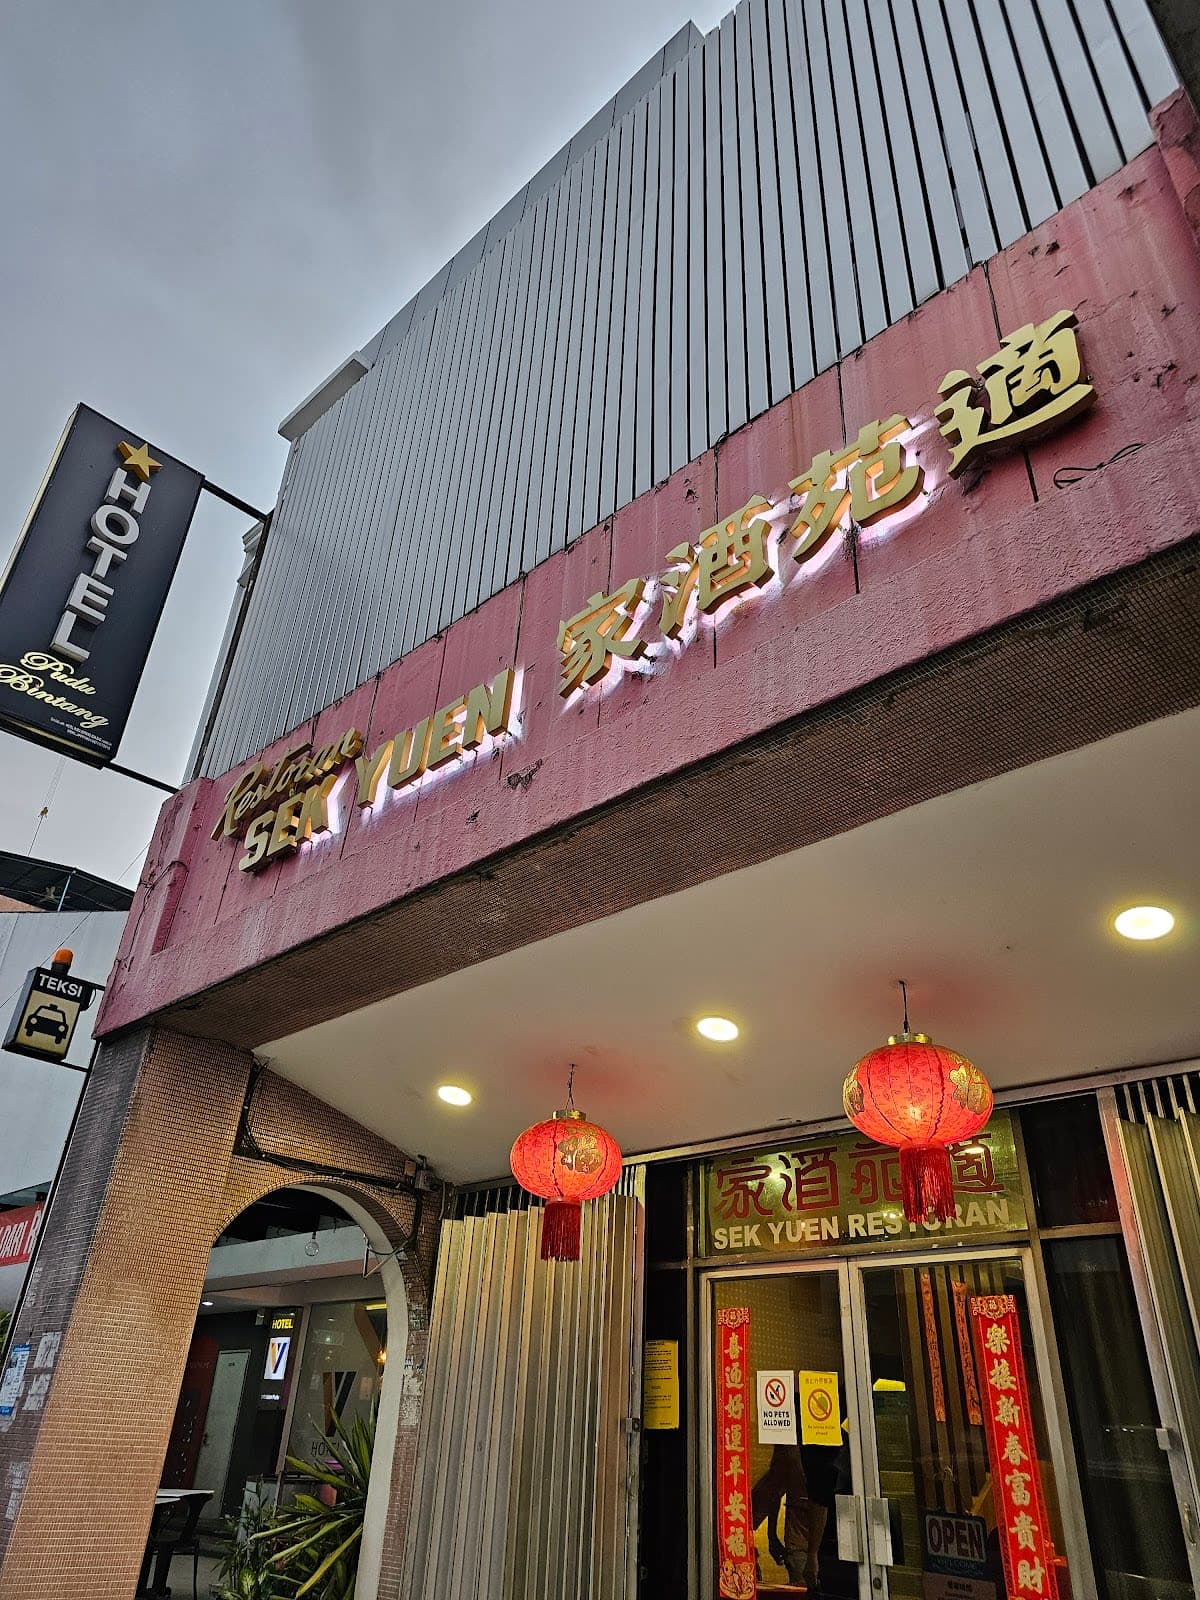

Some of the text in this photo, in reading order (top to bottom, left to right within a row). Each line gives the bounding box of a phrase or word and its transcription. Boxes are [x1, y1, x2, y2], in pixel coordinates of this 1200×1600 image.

[50, 467, 151, 662] HOTEL
[20, 652, 96, 694] Pudu
[0, 664, 109, 728] Bintang
[239, 667, 515, 873] SEK YUEN
[39, 974, 83, 998] TEKSI
[714, 1223, 761, 1250] SEK
[768, 1215, 839, 1242] YUEN
[272, 1318, 294, 1329] HOTEL
[763, 1410, 773, 1418] NO
[763, 1419, 791, 1427] ALLOWED
[928, 1518, 984, 1560] OPEN
